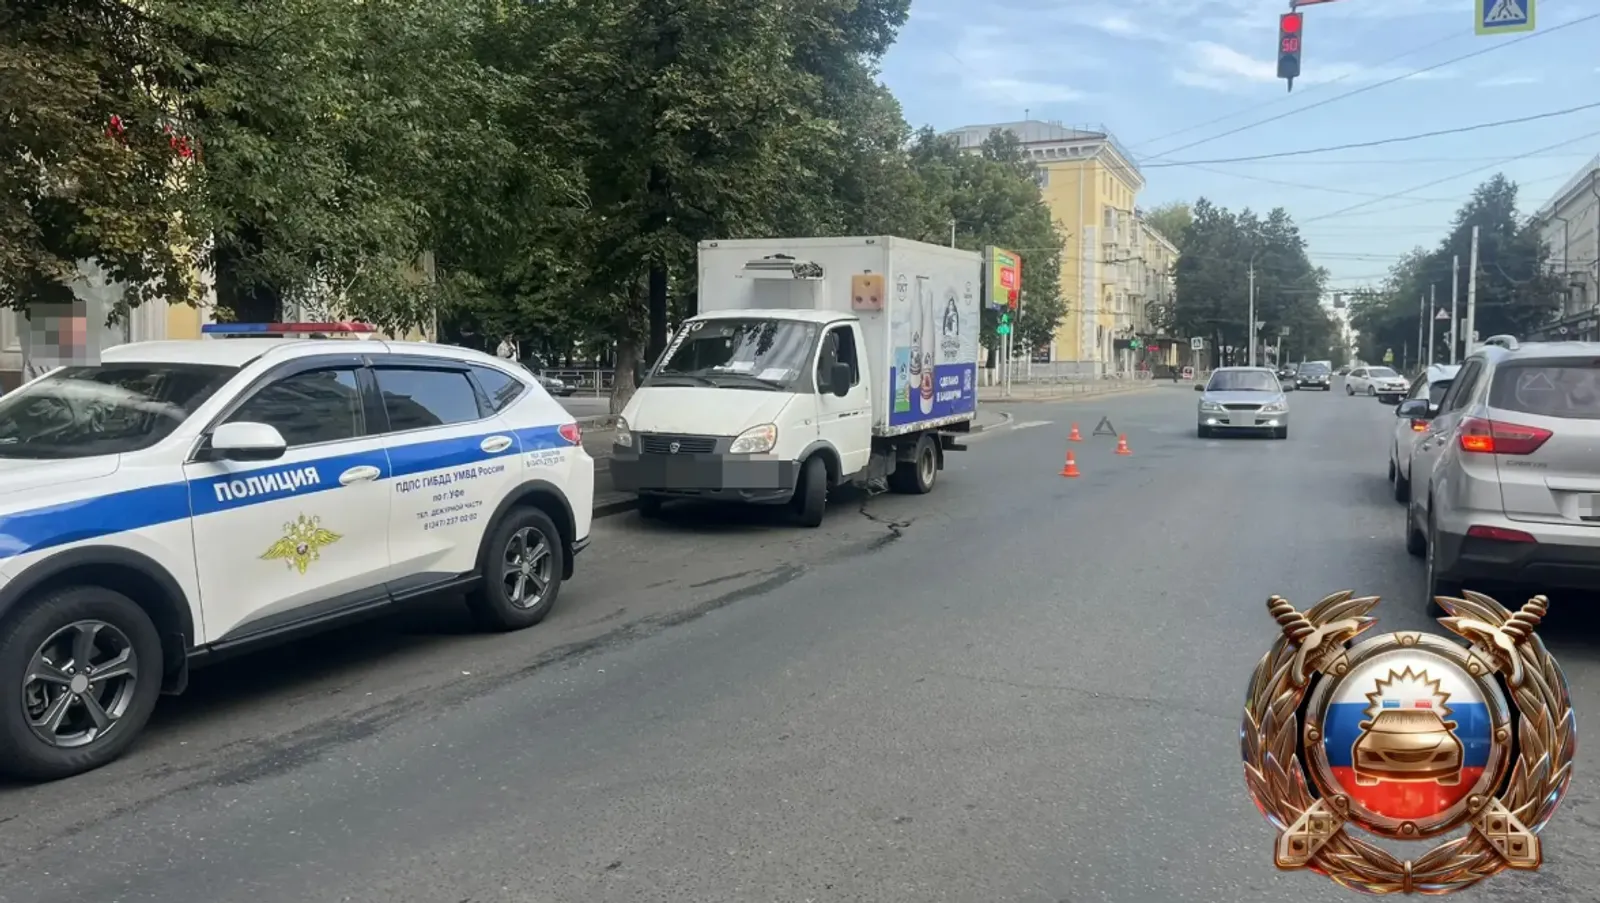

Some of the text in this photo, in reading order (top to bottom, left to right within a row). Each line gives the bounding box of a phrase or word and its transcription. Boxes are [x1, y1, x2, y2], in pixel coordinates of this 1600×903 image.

[1282, 38, 1298, 52] 50
[213, 466, 321, 501] ПОЛИЦИЯ
[395, 465, 505, 493] ПДПС ГИБДД УМВД России
